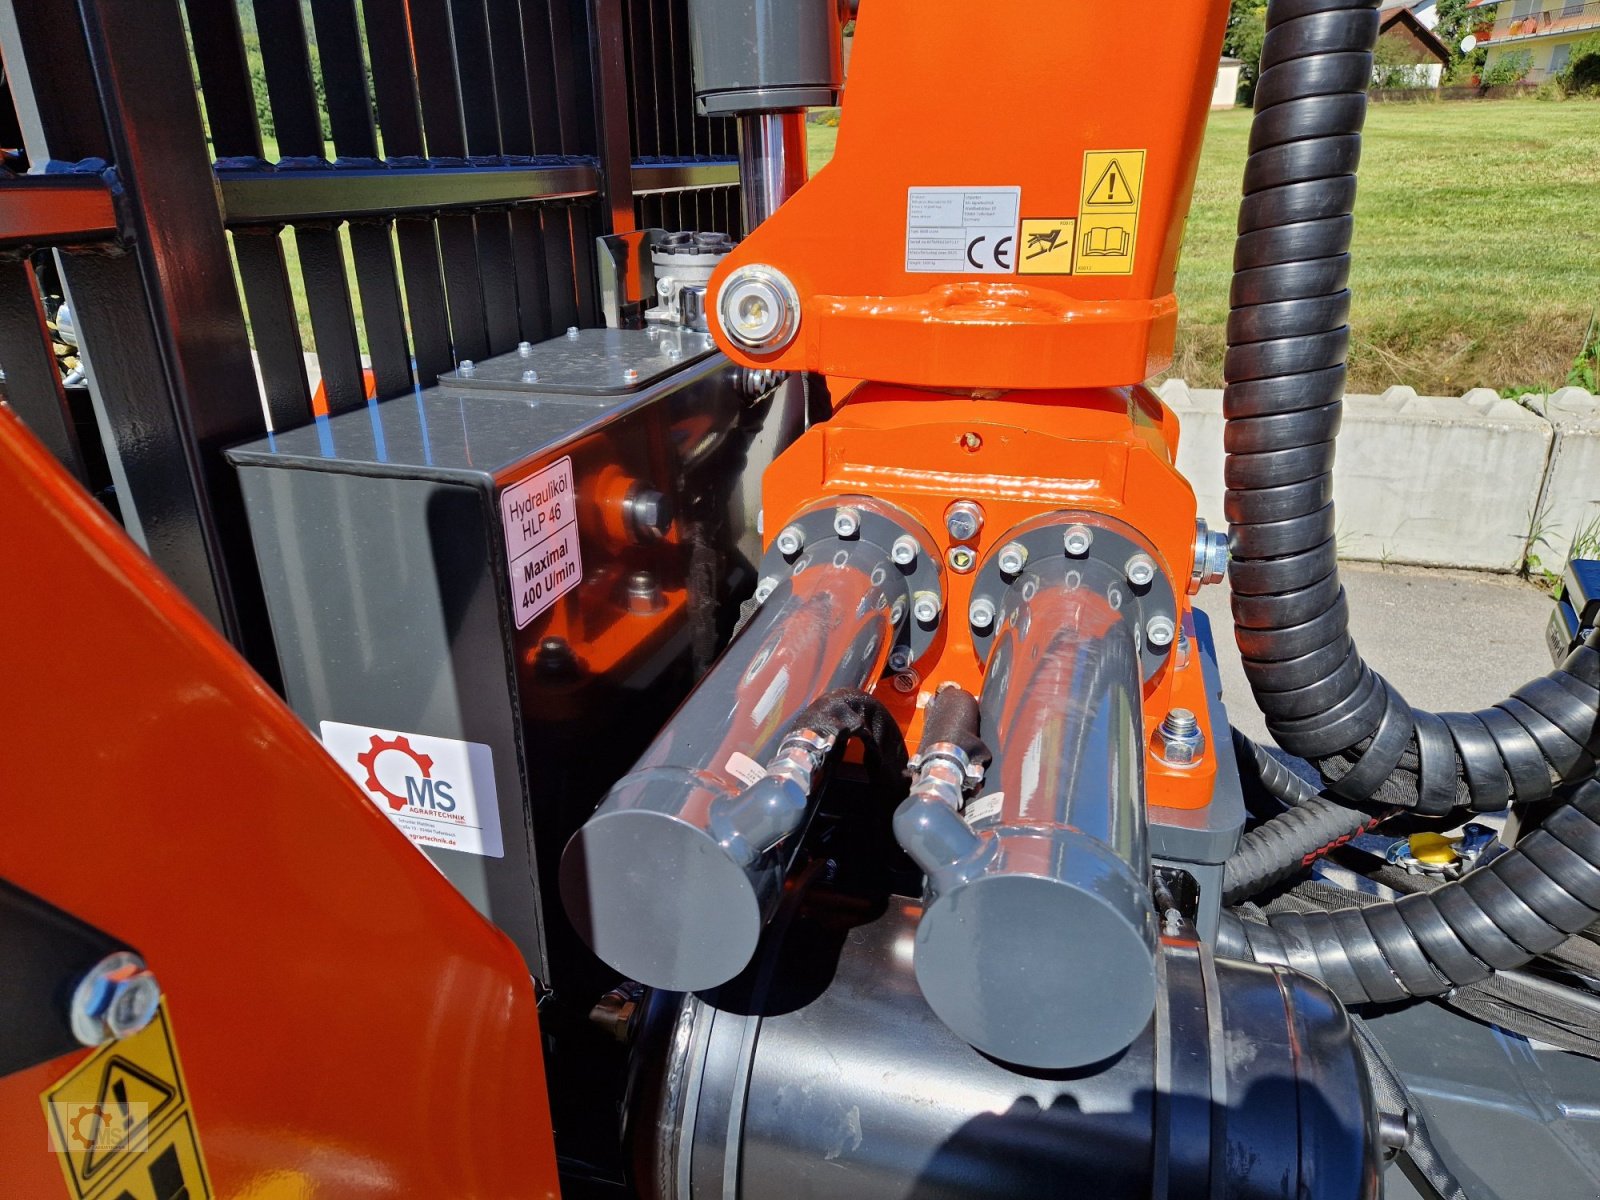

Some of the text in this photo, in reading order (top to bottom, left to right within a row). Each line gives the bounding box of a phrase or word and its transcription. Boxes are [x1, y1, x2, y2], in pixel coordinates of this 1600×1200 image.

[967, 235, 1013, 270] CE
[509, 473, 568, 522] Hydrauliköl
[522, 502, 562, 541] HLP 46
[523, 538, 569, 583] Maximal
[522, 561, 576, 609] 400 U/min
[405, 775, 456, 812] MS
[409, 807, 466, 821] AGRARTECHNIK
